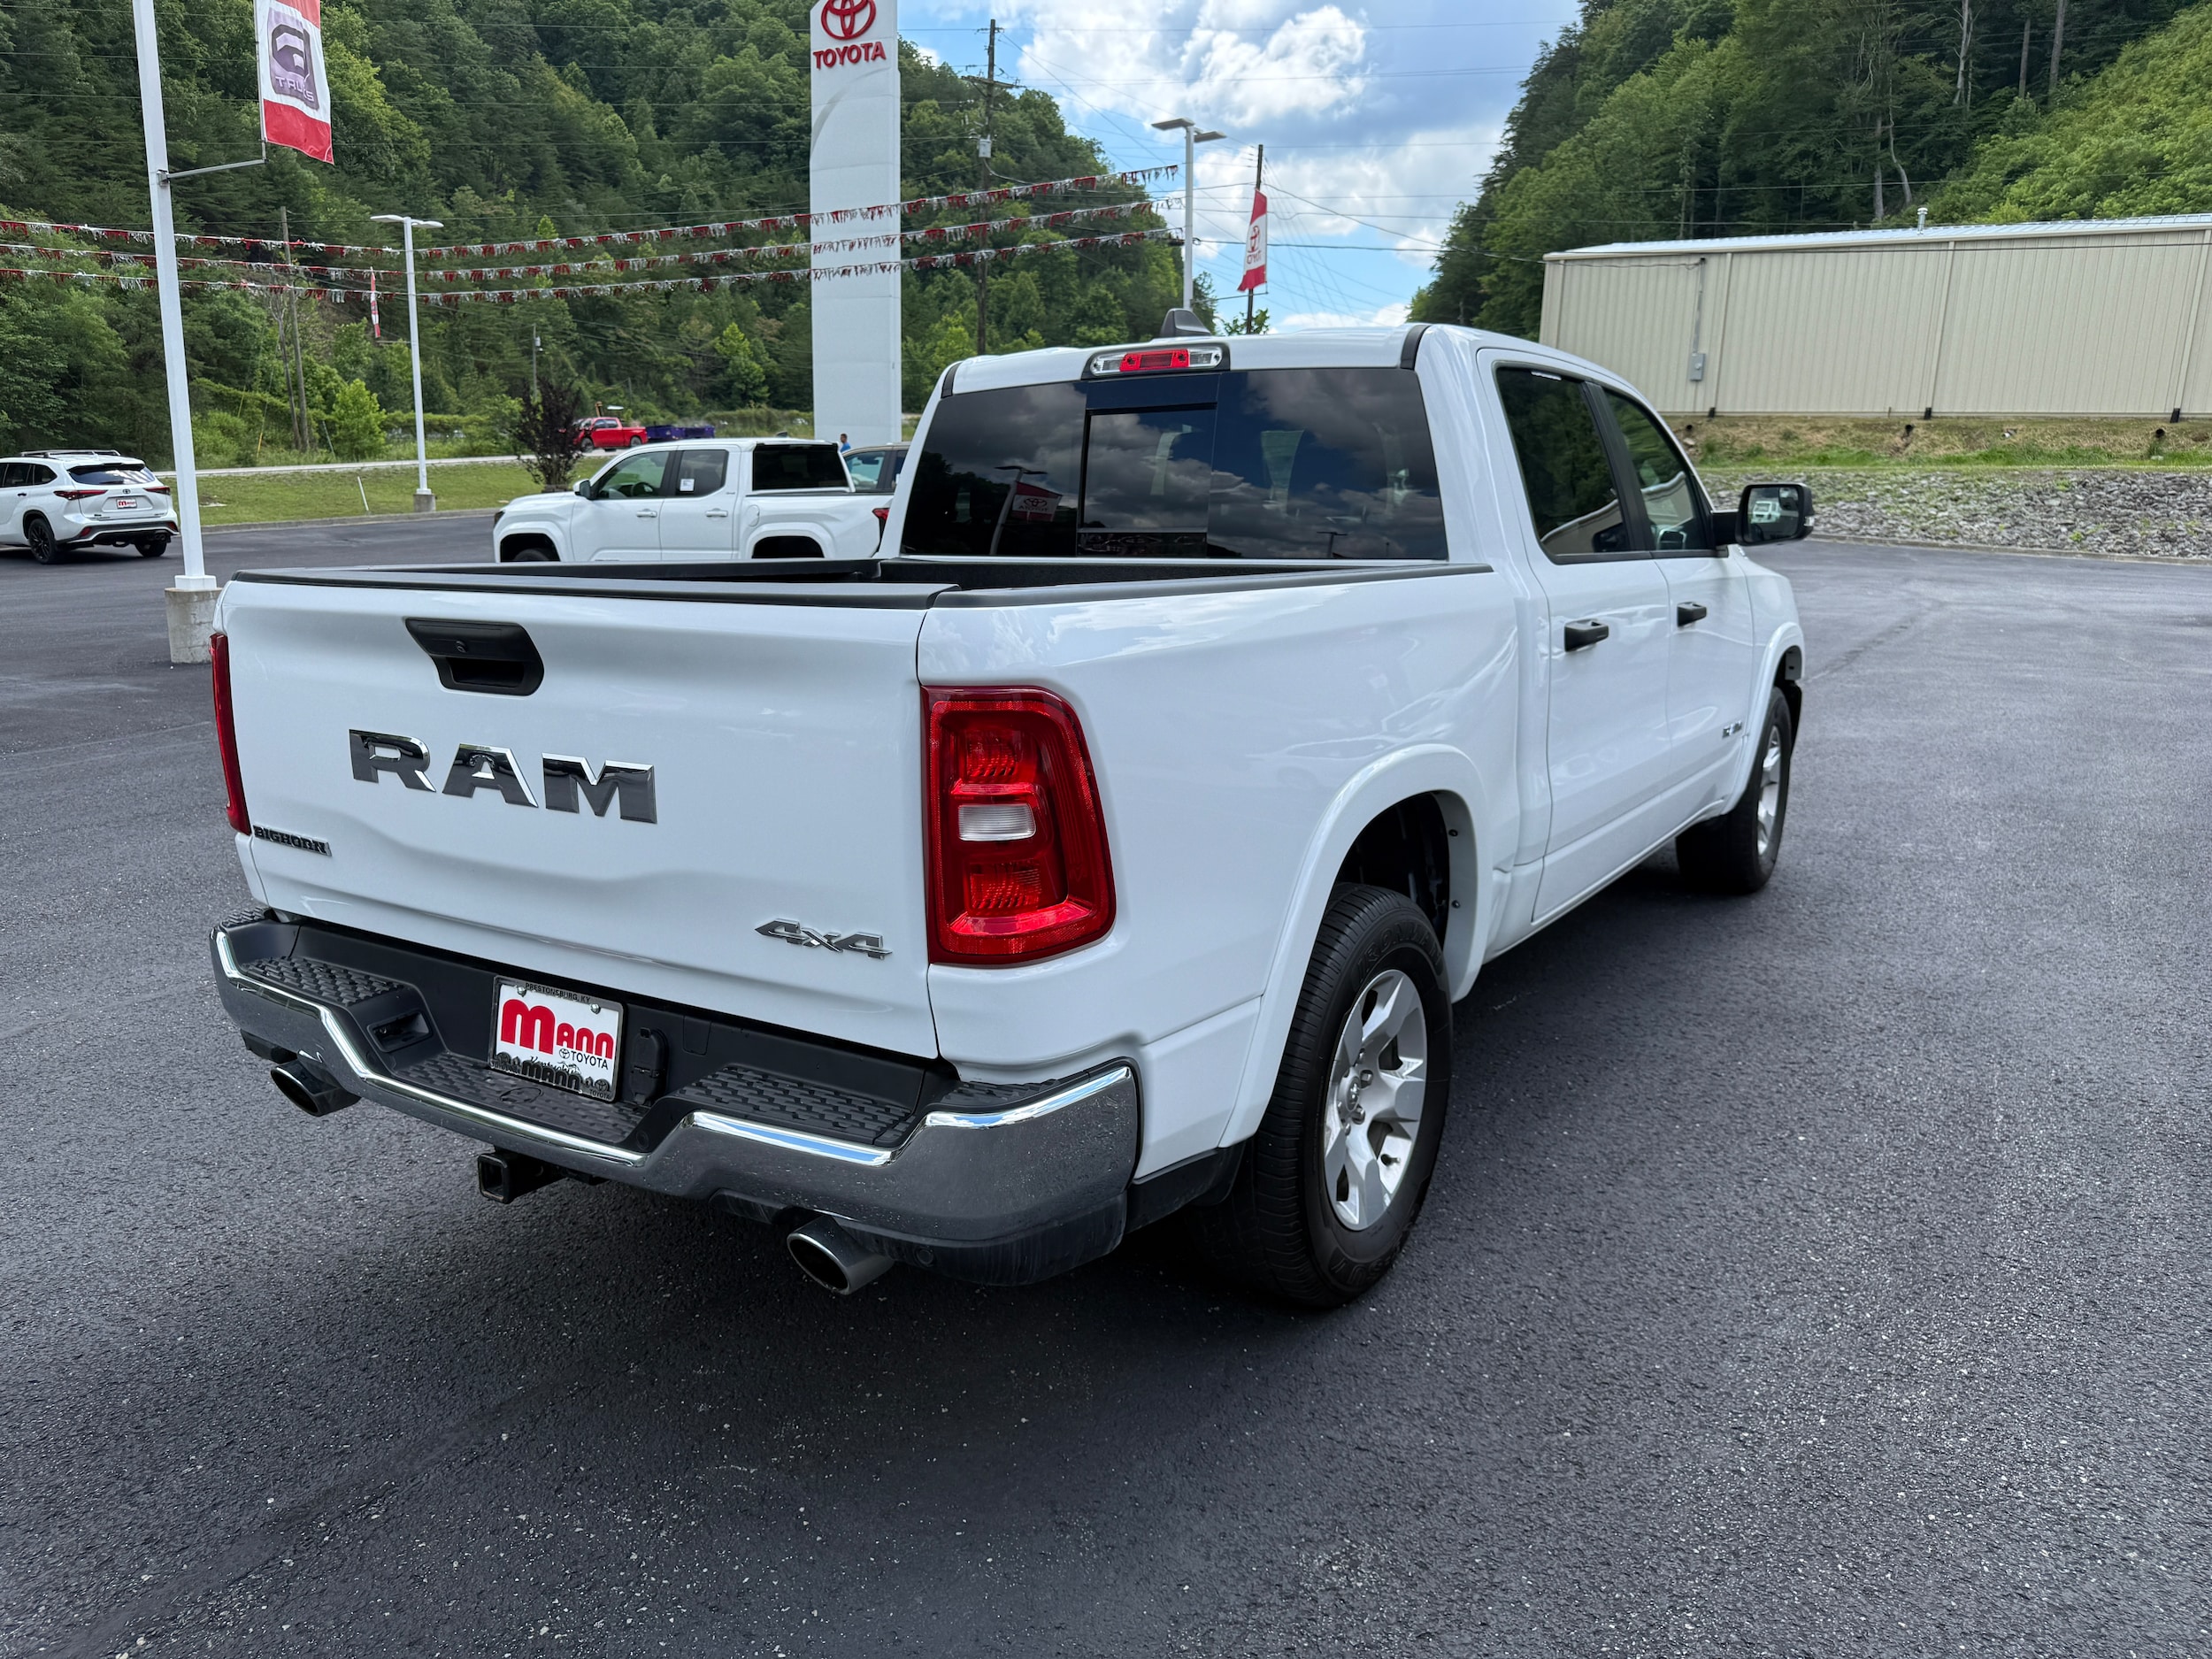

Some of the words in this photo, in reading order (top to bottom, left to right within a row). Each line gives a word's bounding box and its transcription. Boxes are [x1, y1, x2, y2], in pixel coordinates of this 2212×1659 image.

[813, 41, 887, 70] TOYOTA
[349, 728, 657, 824] RAM
[580, 995, 591, 1004] KY
[571, 1050, 609, 1071] TOYOTA
